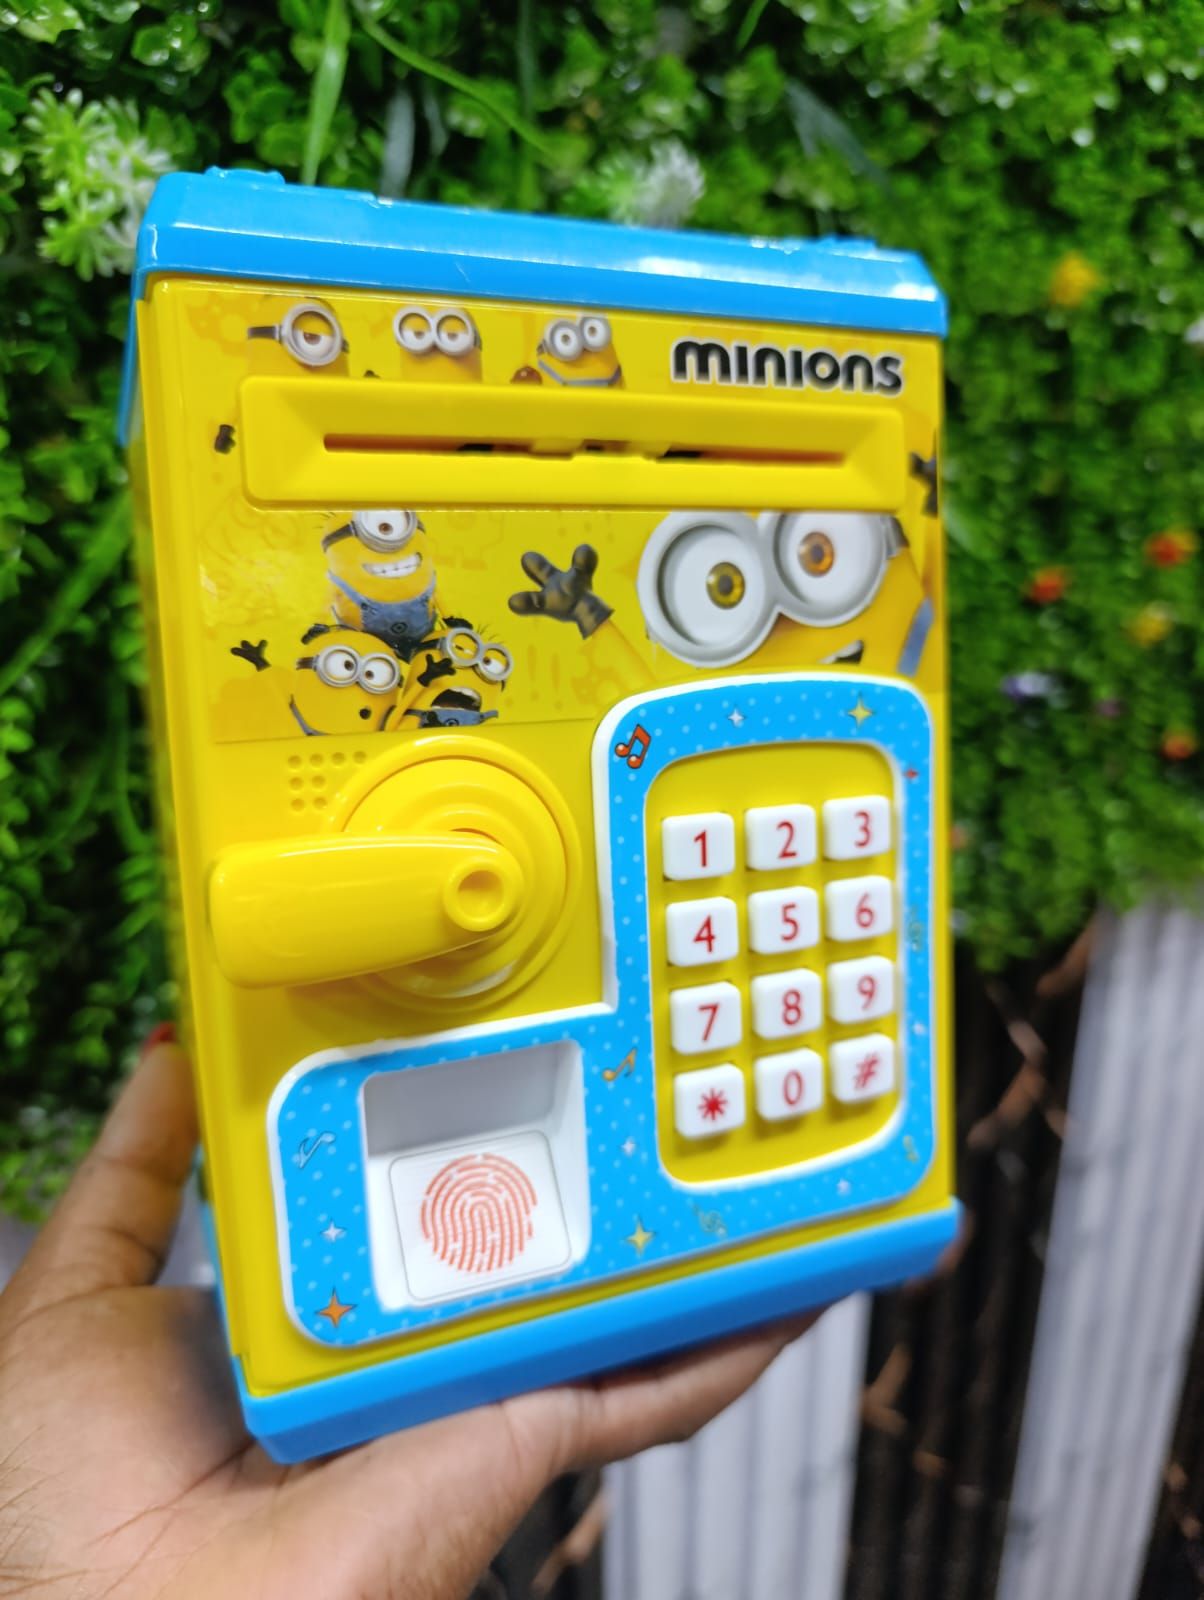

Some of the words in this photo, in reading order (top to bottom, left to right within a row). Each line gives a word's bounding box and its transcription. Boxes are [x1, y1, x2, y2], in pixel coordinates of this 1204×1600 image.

[692, 829, 710, 869] 1
[776, 819, 798, 860] 2
[855, 809, 873, 849] 3
[692, 914, 717, 954] 4
[781, 903, 800, 942] 5
[855, 893, 875, 930] 6
[698, 1002, 721, 1042] 7
[782, 988, 804, 1027] 8
[858, 975, 877, 1009] 9
[783, 1070, 804, 1107] 0
[855, 1051, 881, 1091] #
